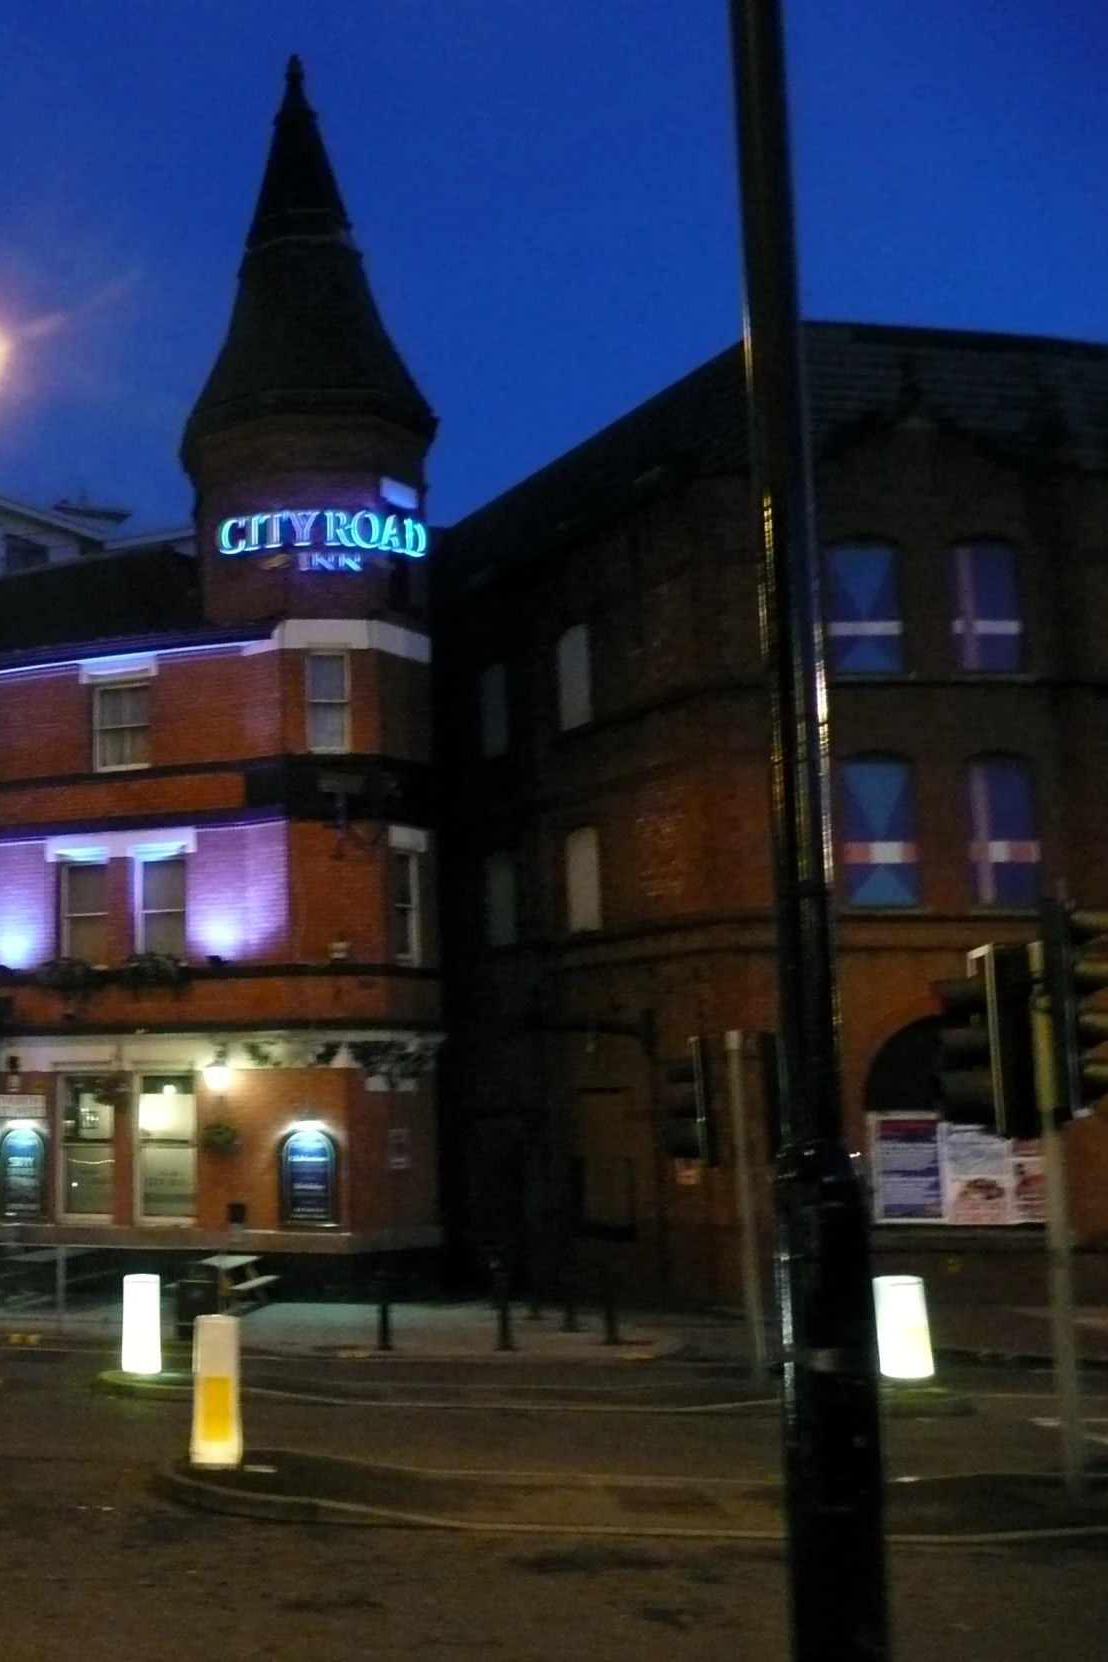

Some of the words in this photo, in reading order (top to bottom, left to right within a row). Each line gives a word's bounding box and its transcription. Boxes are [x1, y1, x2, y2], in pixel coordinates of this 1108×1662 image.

[219, 510, 320, 554] CITY
[324, 510, 427, 557] ROAD
[298, 552, 362, 571] INN
